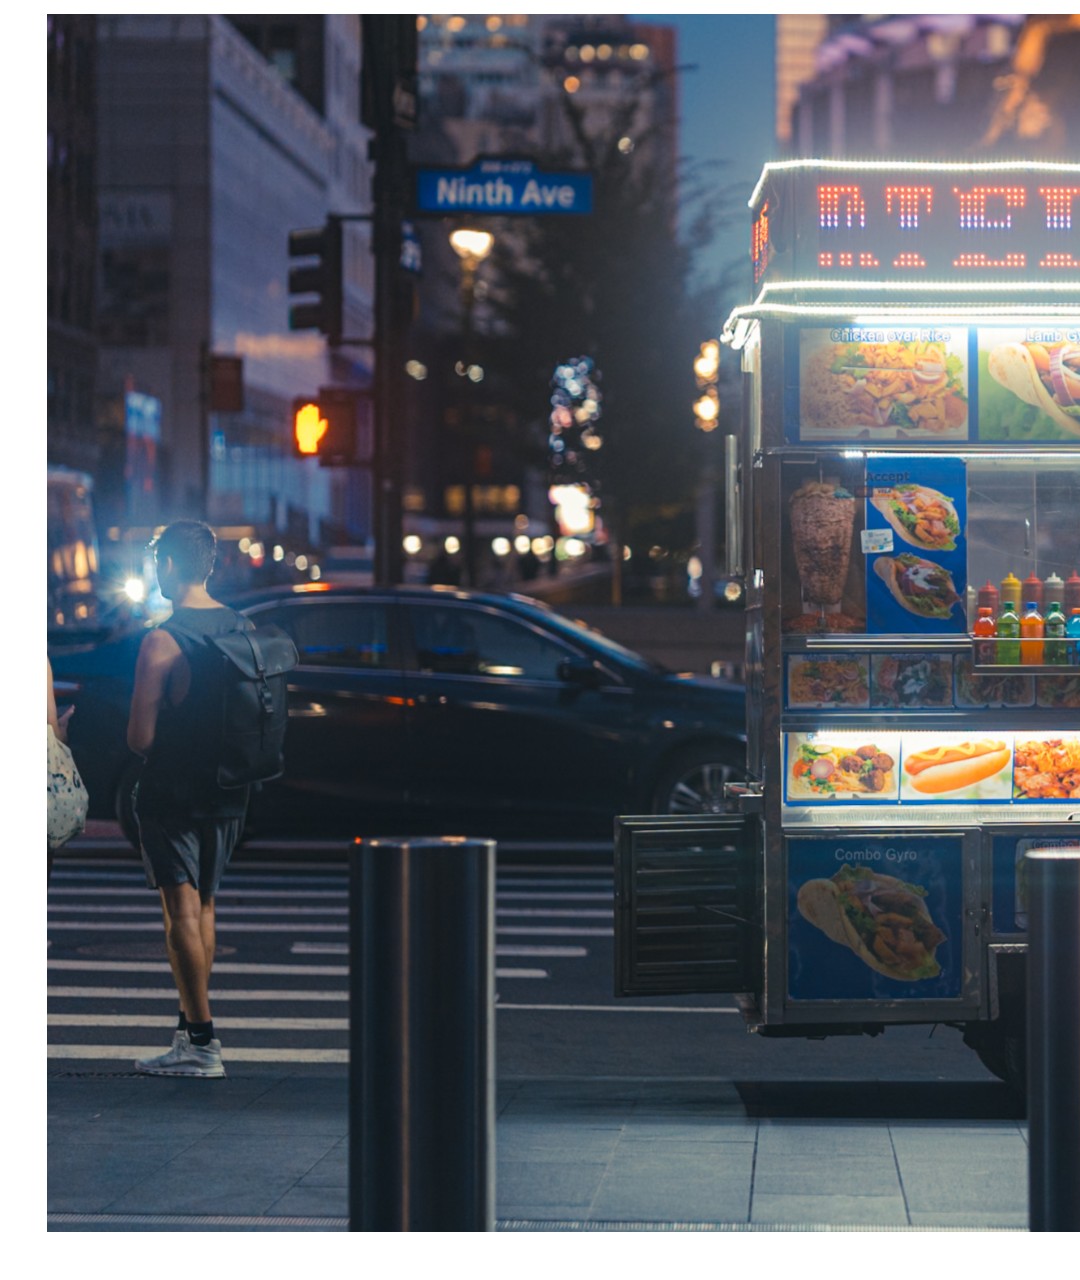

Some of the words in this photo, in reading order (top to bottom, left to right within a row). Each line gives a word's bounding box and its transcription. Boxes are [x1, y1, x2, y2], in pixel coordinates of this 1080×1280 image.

[436, 175, 514, 207] Ninth
[519, 178, 577, 209] Ave
[830, 328, 884, 343] Chicken
[887, 331, 918, 343] over
[920, 328, 951, 343] Rice
[1026, 328, 1062, 343] Lamb
[867, 471, 910, 484] Accept
[834, 847, 882, 861] Combo
[885, 847, 917, 864] Gyro
